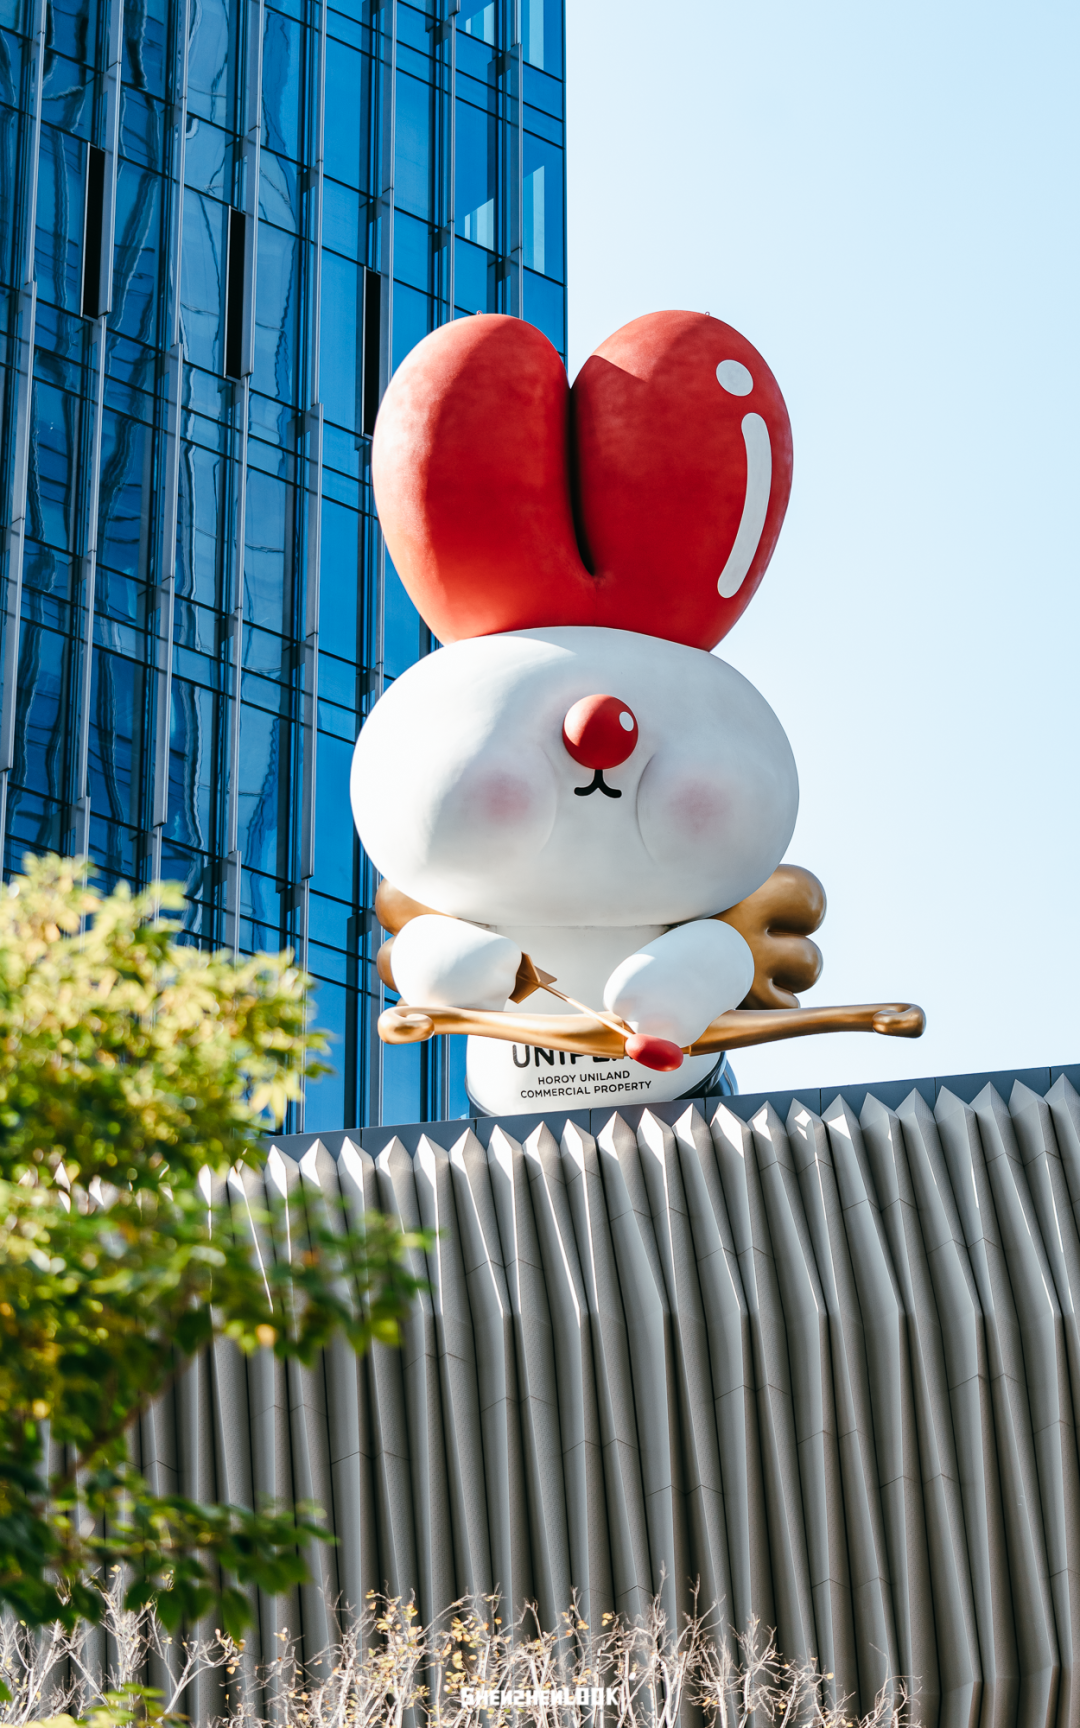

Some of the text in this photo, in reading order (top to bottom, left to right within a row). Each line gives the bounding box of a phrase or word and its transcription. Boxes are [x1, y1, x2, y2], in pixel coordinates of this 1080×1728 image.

[537, 1070, 630, 1085] HOROY UNILAND
[520, 1081, 652, 1098] COMMERCIAL PROPERTY
